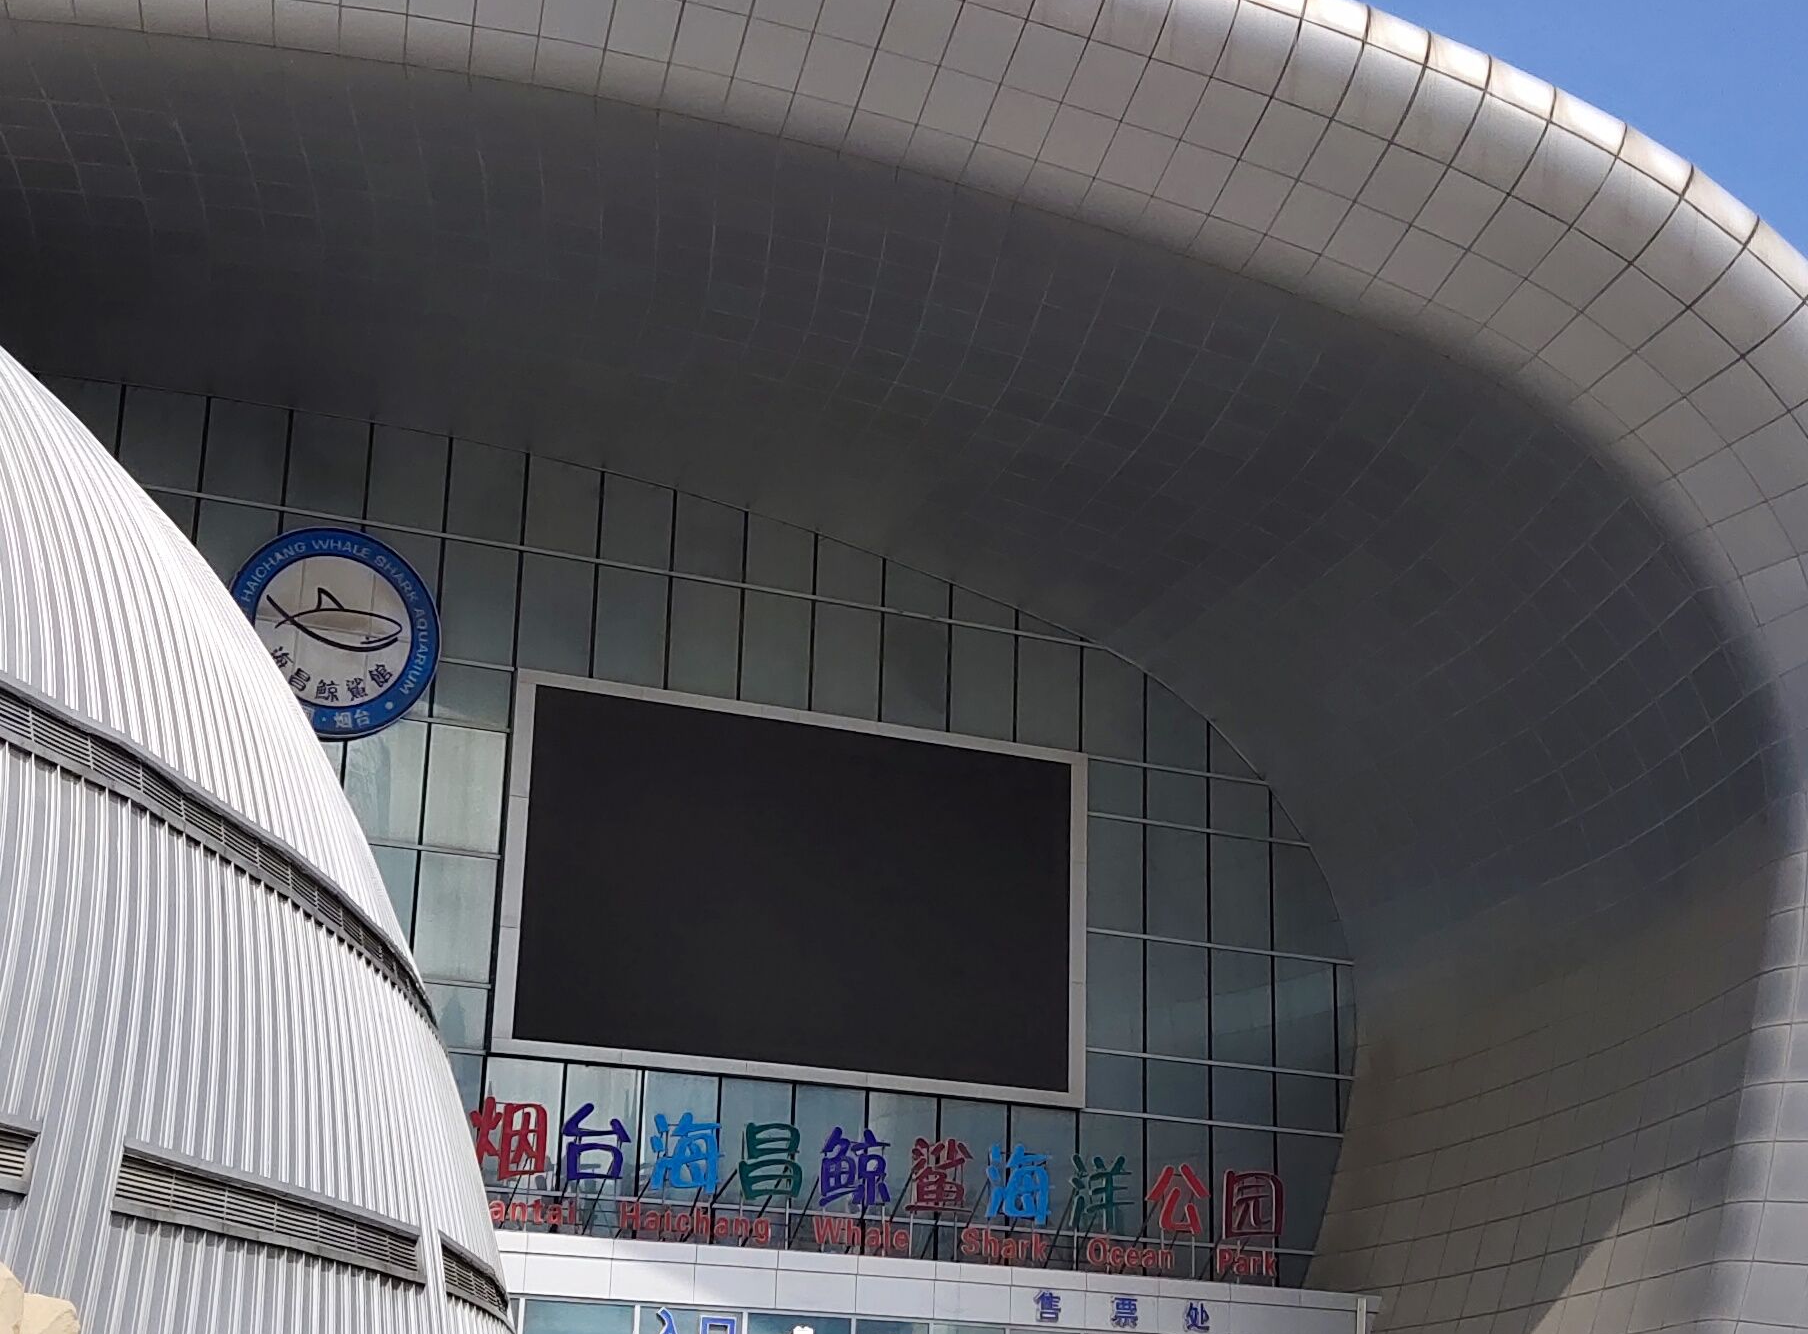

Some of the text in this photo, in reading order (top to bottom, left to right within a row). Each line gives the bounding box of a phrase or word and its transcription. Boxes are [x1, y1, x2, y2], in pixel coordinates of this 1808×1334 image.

[241, 539, 429, 696] HAICHANG WHALE SHARK AQUARIUM
[469, 1096, 1285, 1239] 烟台海昌鲸鲨海洋公园
[488, 1197, 1278, 1277] antai Haichang Whale Shark Ocean Park
[1034, 1291, 1210, 1332] 售票处
